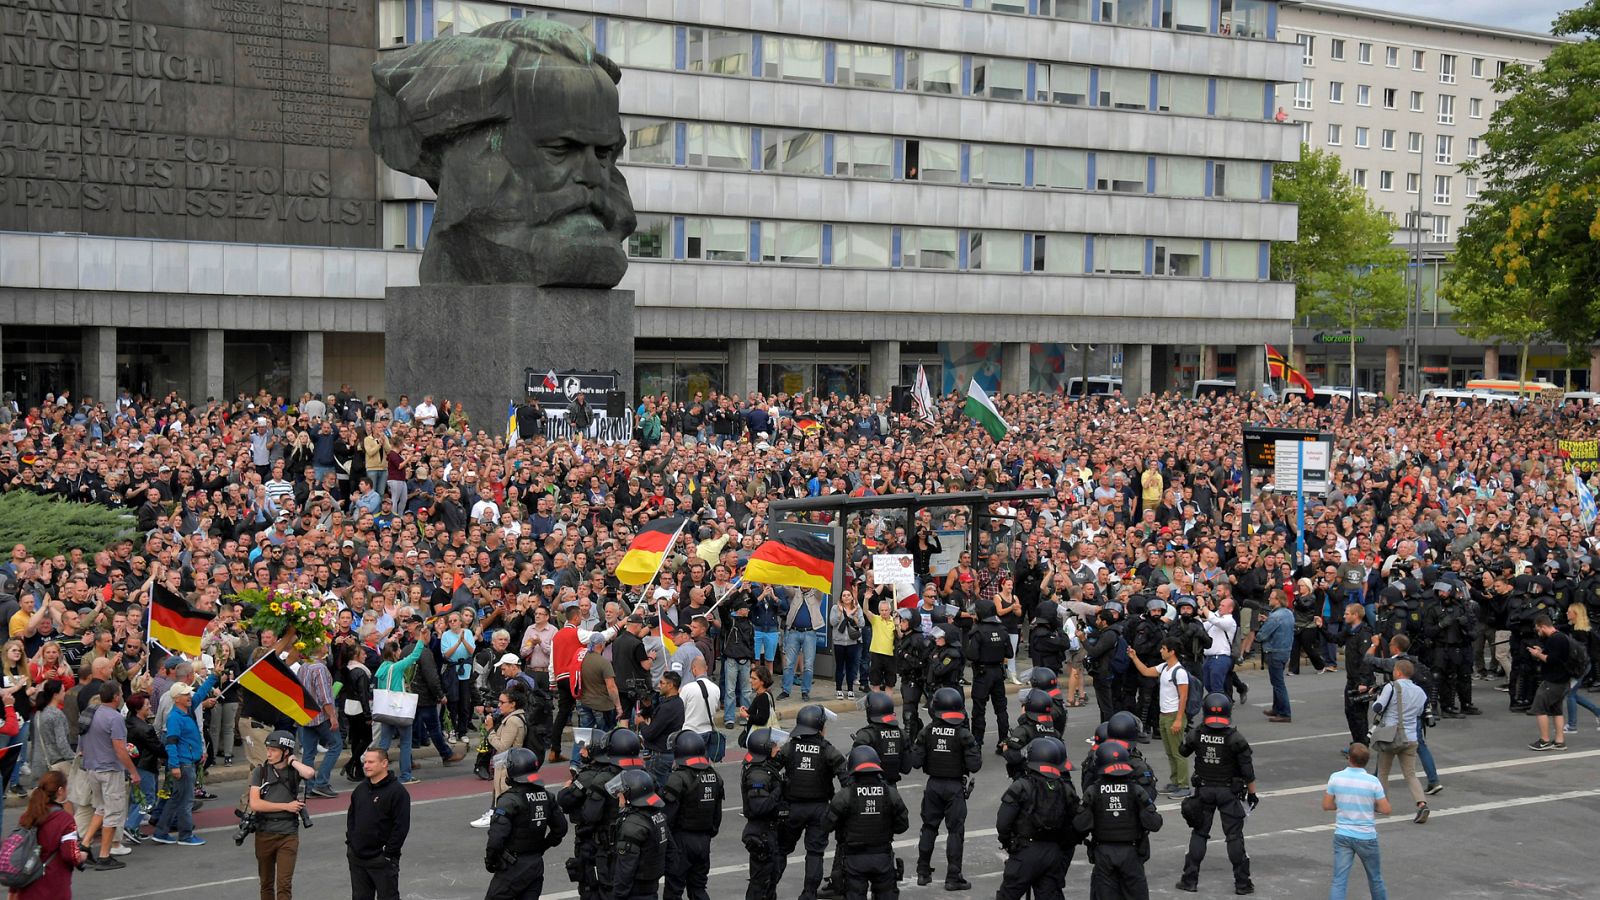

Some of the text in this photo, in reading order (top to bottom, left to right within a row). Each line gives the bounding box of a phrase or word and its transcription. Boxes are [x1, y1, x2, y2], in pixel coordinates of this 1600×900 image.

[880, 730, 900, 739] POLIZEI
[932, 727, 956, 736] POLIZEI
[1200, 734, 1224, 744] POLIZEI
[796, 744, 820, 754] POLIZEI
[700, 773, 717, 783] OLIZEI
[857, 786, 884, 796] POLIZEI
[1100, 784, 1128, 794] POLIZEI
[526, 792, 548, 802] POLIZEI
